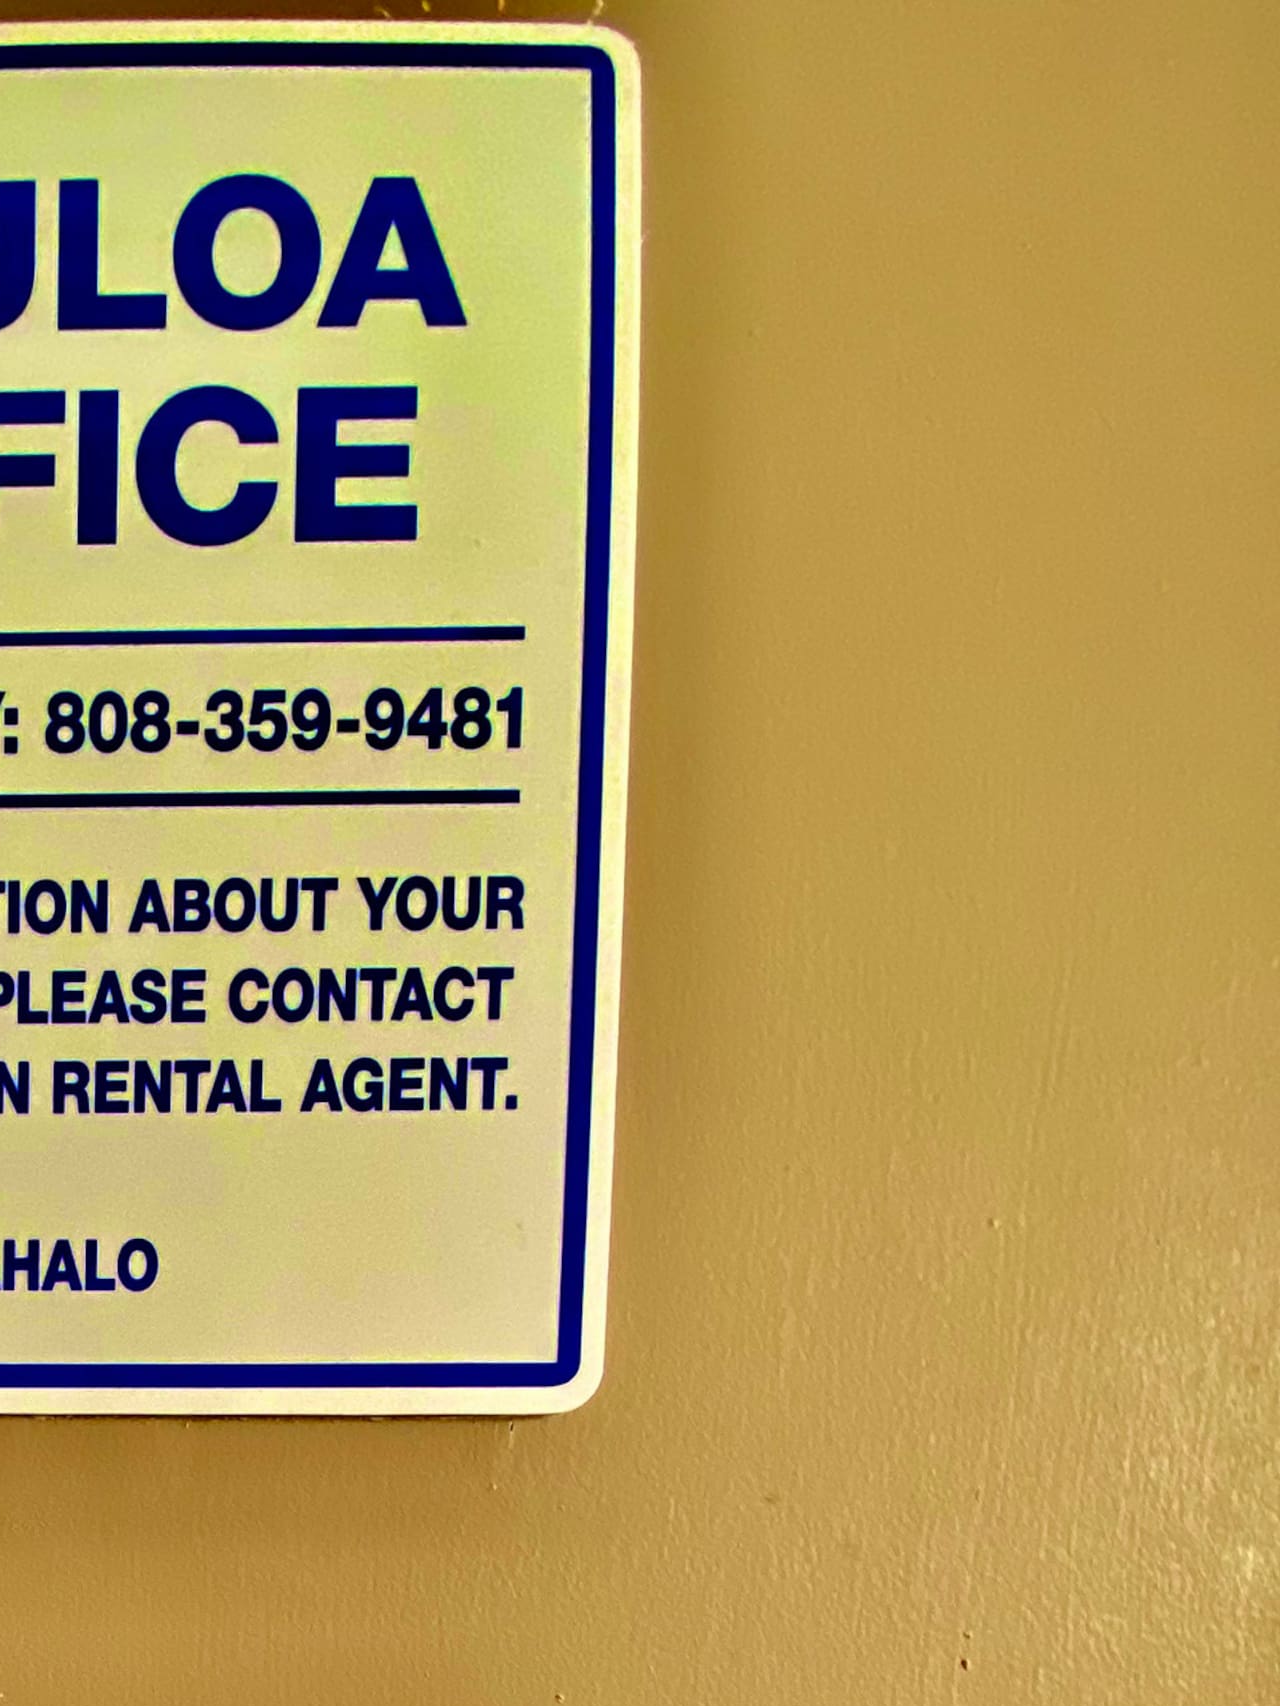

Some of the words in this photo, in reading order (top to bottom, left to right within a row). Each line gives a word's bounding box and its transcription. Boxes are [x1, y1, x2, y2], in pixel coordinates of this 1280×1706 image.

[45, 686, 523, 755] 808-359-9481
[128, 877, 339, 933] ABOUT
[356, 875, 525, 932] YOUR
[227, 966, 515, 1024] CONTACT
[52, 1059, 282, 1114] RENTAL
[300, 1057, 518, 1113] AGENT.
